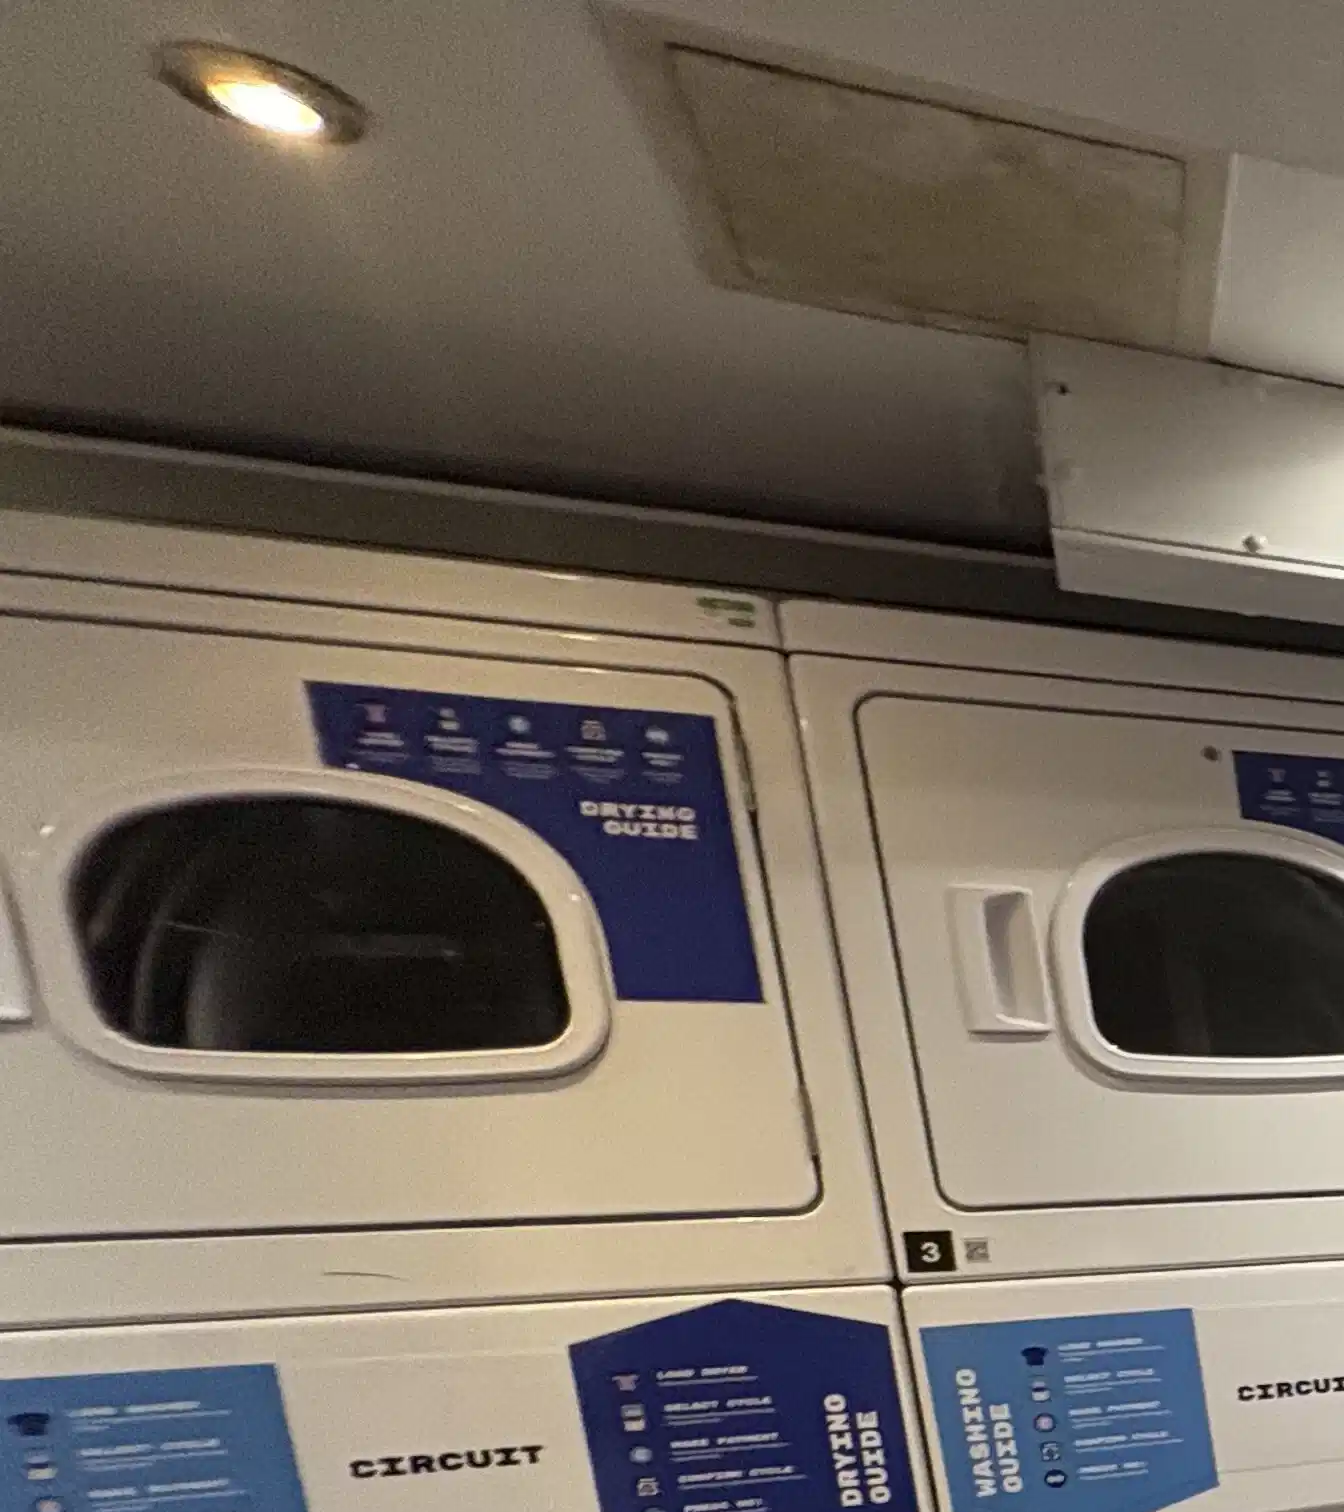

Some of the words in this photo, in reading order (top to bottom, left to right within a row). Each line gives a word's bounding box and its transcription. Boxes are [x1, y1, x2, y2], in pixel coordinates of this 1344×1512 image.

[580, 800, 697, 822] DRYING
[603, 821, 699, 841] GUIDE
[919, 1241, 942, 1264] 3
[348, 1444, 546, 1481] CIRCUIT
[824, 1392, 865, 1508] DRYING
[855, 1410, 892, 1506] GUIDE
[955, 1367, 998, 1498] WASHING
[988, 1402, 1024, 1494] GUIDE
